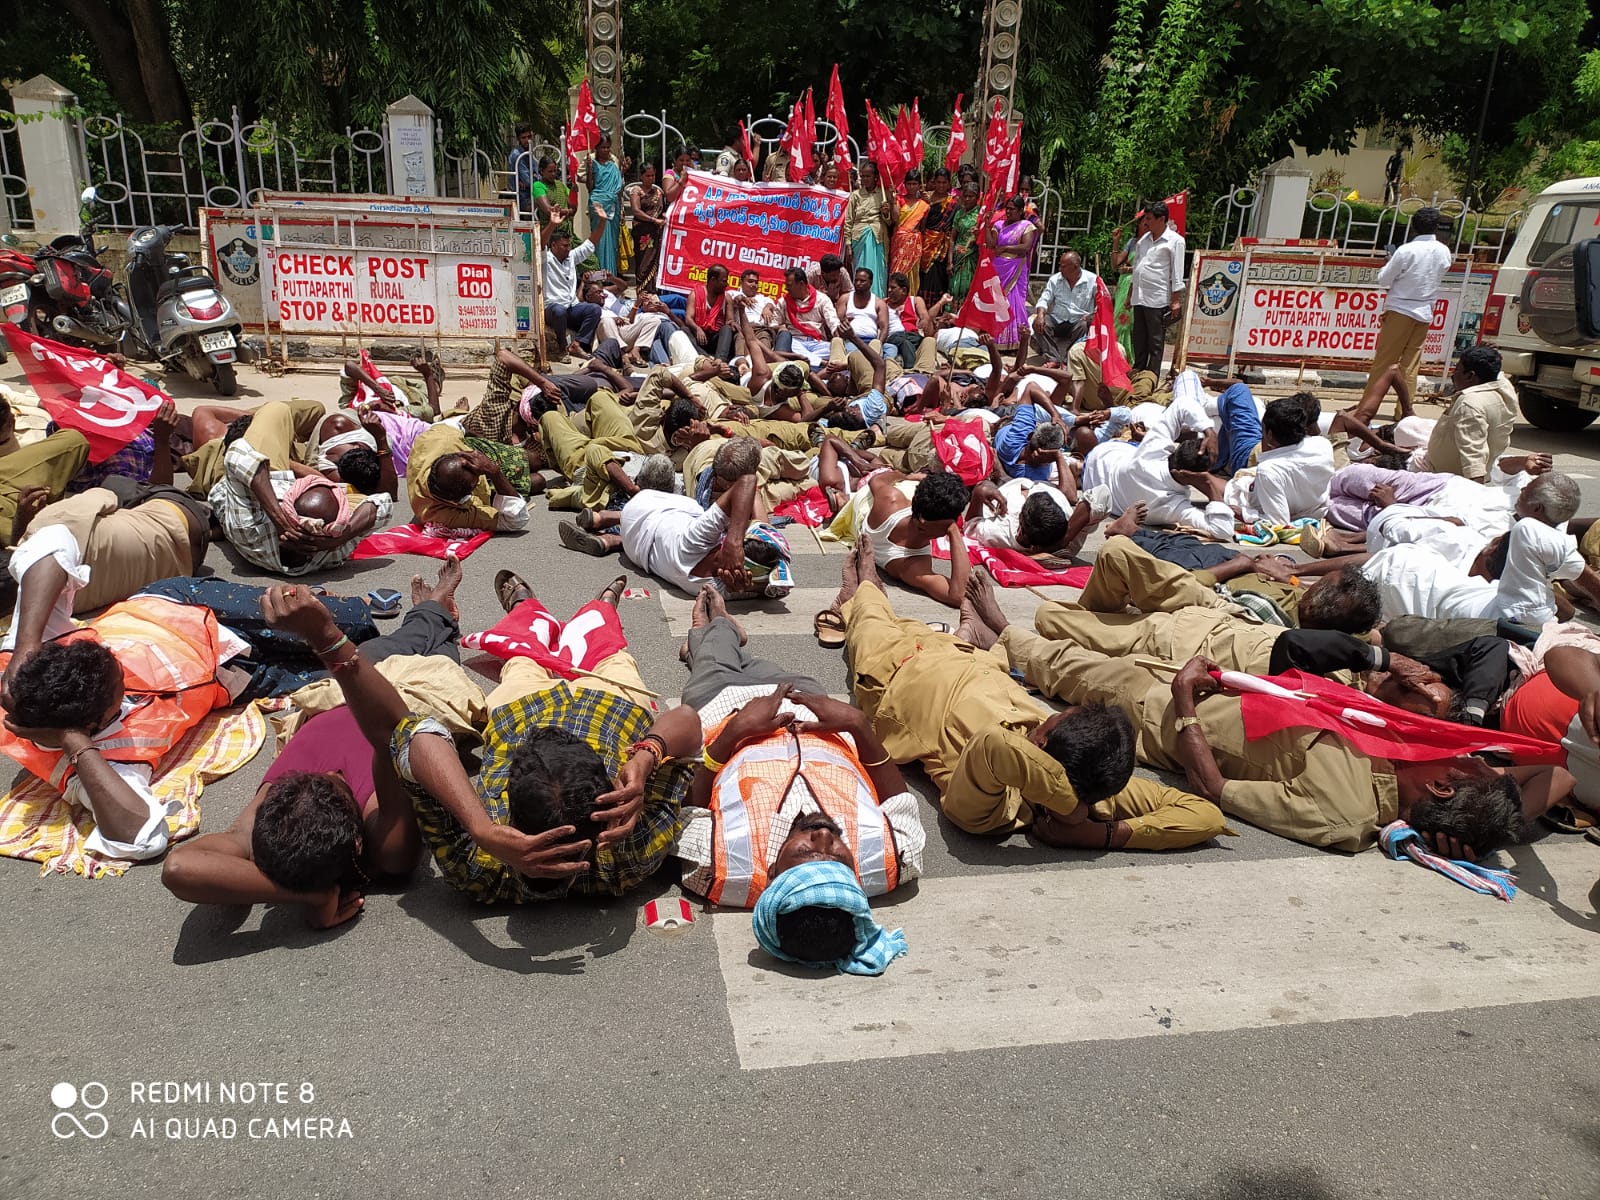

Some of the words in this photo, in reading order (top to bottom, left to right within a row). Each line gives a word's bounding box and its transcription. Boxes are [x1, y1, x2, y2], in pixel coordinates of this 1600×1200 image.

[700, 238, 737, 260] CITU
[278, 253, 354, 276] CHECK
[368, 256, 429, 279] POST
[461, 266, 488, 278] Dial
[1228, 262, 1241, 273] 32
[282, 280, 353, 299] PUTTAPARTHI
[370, 281, 405, 300] RURAL
[460, 281, 491, 296] 100
[1254, 289, 1324, 309] CHECK
[279, 300, 327, 321] STOP
[331, 301, 345, 322] &
[346, 302, 435, 325] PROCEED
[1265, 310, 1331, 328] PUTTAPARTHI
[1335, 312, 1367, 329] RURAL
[1188, 335, 1227, 346] POLICE
[1247, 328, 1293, 348] STOP
[1292, 330, 1304, 348] &
[1306, 330, 1382, 351] PROCEE
